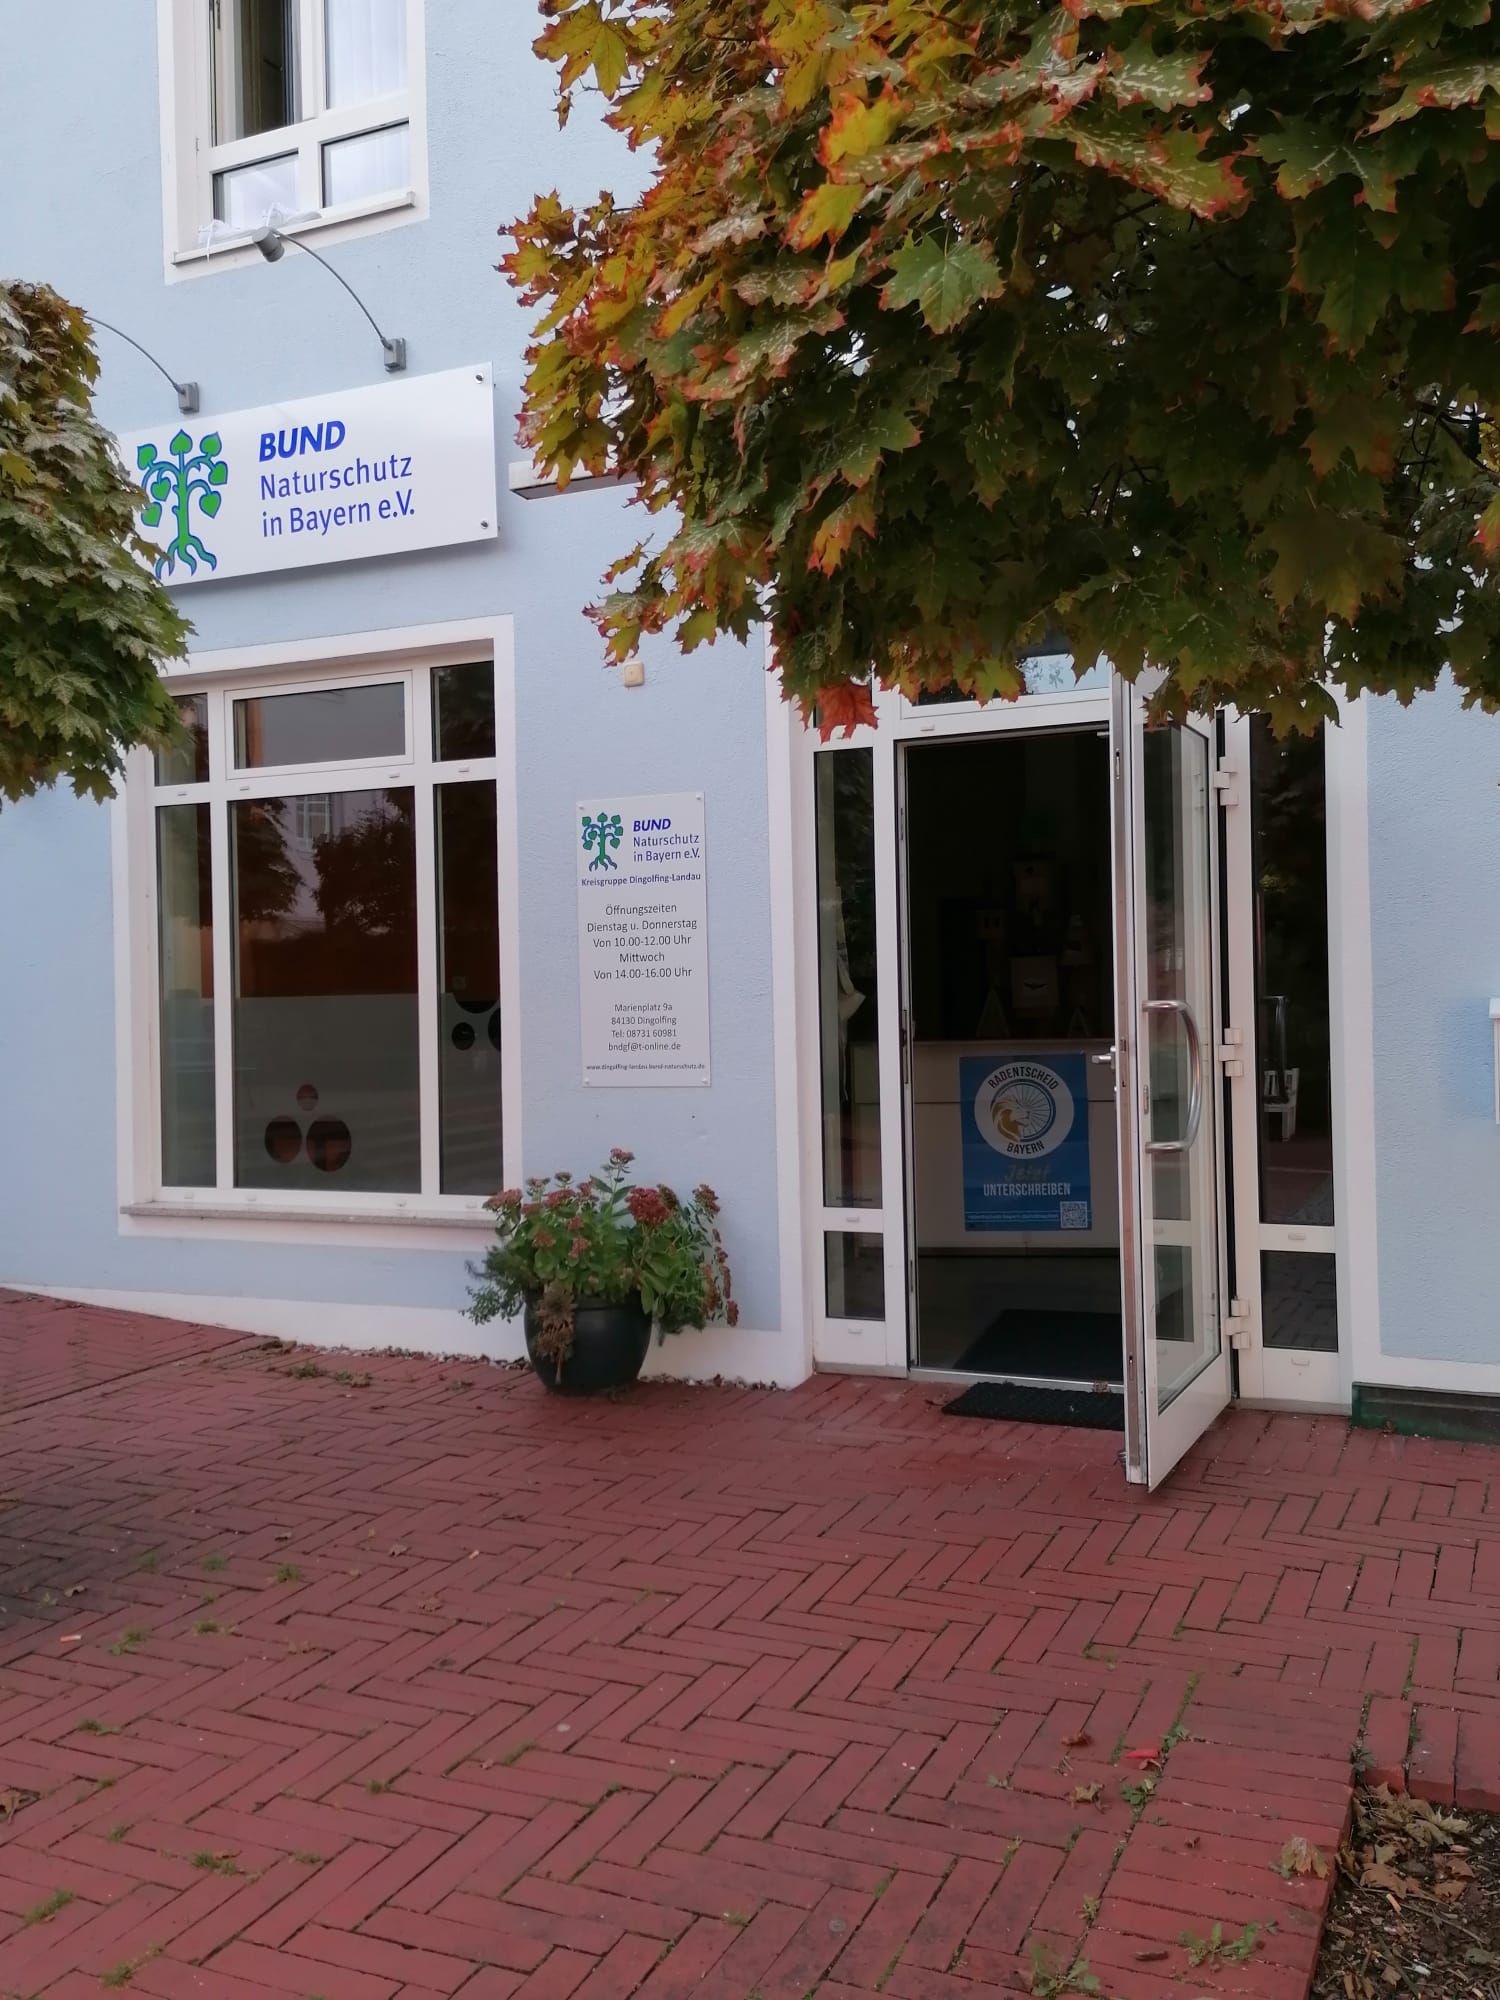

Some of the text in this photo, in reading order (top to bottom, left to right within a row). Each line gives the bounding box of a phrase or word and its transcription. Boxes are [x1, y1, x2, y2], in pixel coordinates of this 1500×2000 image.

[259, 420, 346, 462] BUND
[260, 455, 412, 500] Naturschutz
[263, 489, 416, 538] in Bayern e.V.
[633, 818, 671, 832] BUND
[633, 834, 700, 847] Naturschutz
[633, 848, 700, 863] in Bayern e.V.
[581, 872, 701, 887] Kreisgruppe Dingolfing-Landau
[605, 903, 677, 916] Öffnungszeiten
[587, 919, 697, 933] Dienstag u. Donnerstag
[593, 935, 692, 948] Von 10.00-12.00 Uhr
[620, 952, 665, 963] Mittwoch
[593, 967, 692, 979] Von 14.00-16.00 Uhr
[614, 1003, 673, 1013] Marienplatz 9a
[611, 1015, 677, 1026] 84130 Dingolfing
[612, 1029, 677, 1038] Tel: 08731 60981
[608, 1042, 681, 1052] bndgf@t-online.de
[987, 1066, 1059, 1091] RADENTSCHEID
[1007, 1140, 1045, 1154] BAYERN
[983, 1183, 1071, 1197] UNTERSCHREIBEN
